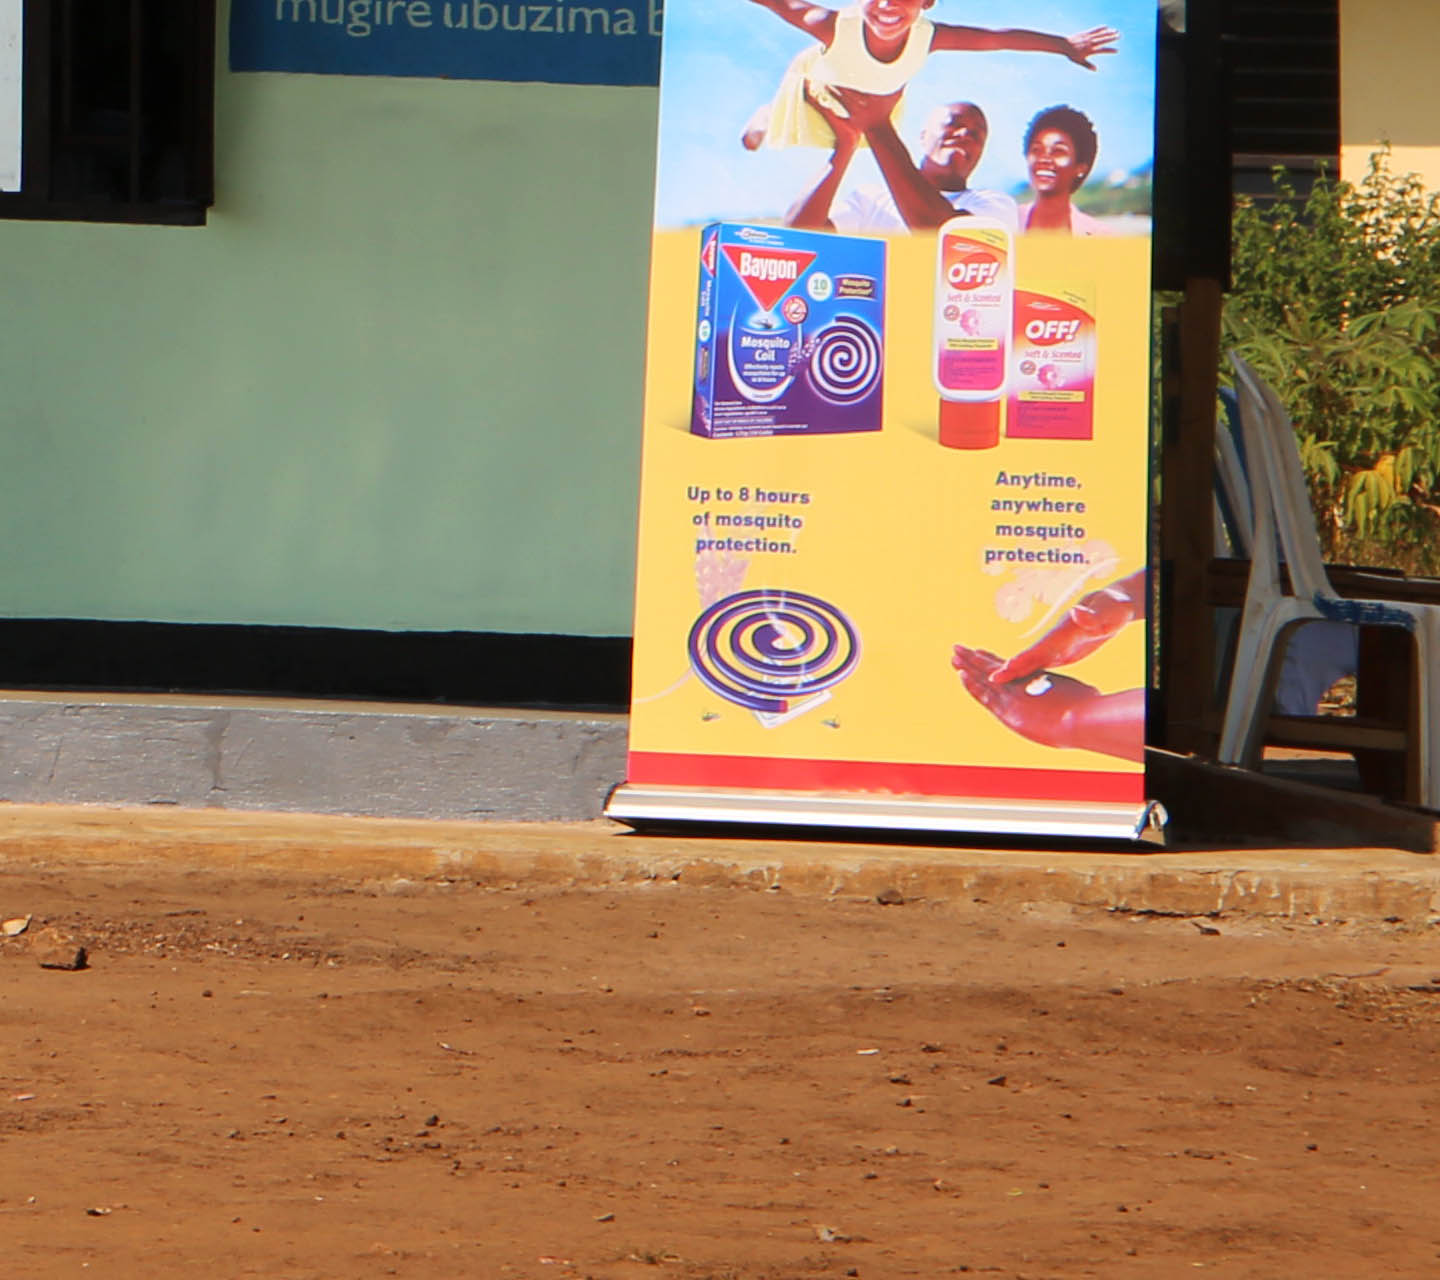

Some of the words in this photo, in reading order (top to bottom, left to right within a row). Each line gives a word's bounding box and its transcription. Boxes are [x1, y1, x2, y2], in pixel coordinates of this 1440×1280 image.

[740, 253, 798, 281] Baygon
[948, 263, 1000, 286] OFF!
[1025, 320, 1078, 342] OFF!
[741, 335, 790, 351] Mosquito
[755, 348, 775, 362] Coil
[996, 471, 1081, 489] Anytime,
[688, 487, 710, 504] Up
[716, 488, 733, 501] to
[739, 487, 749, 502] 8
[756, 488, 810, 504] hours
[991, 498, 1086, 514] anywhere
[693, 512, 710, 527] of
[716, 514, 802, 530] mosquito
[996, 524, 1085, 541] mosquito
[696, 538, 796, 554] protection.
[986, 549, 1089, 564] protection.
